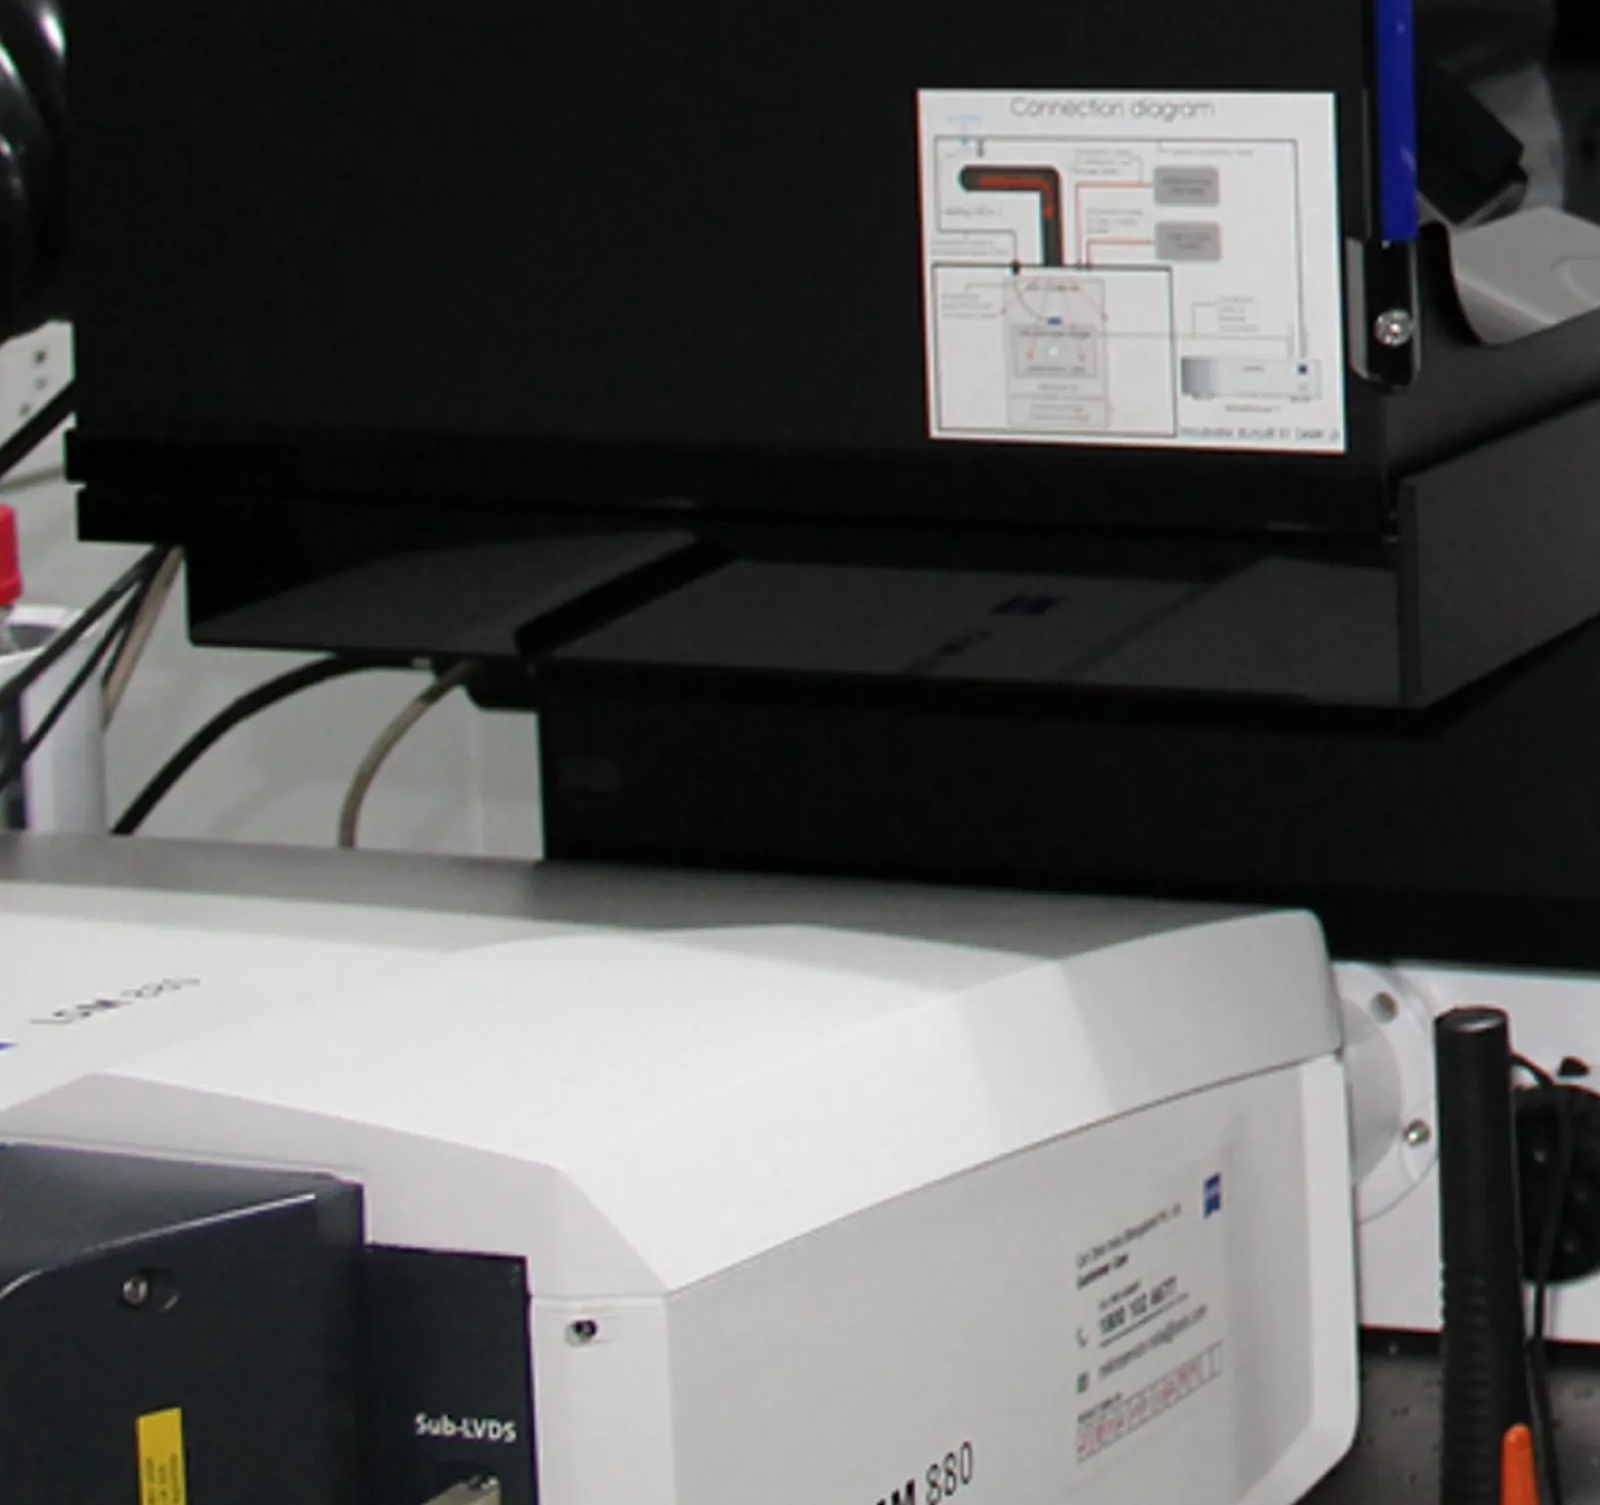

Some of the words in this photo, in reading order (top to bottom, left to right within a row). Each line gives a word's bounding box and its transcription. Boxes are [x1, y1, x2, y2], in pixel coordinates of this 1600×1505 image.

[1010, 96, 1125, 118] Connection
[1130, 96, 1216, 123] diagram
[414, 1411, 517, 1443] Sub-LVDS
[925, 1439, 973, 1505] 880
